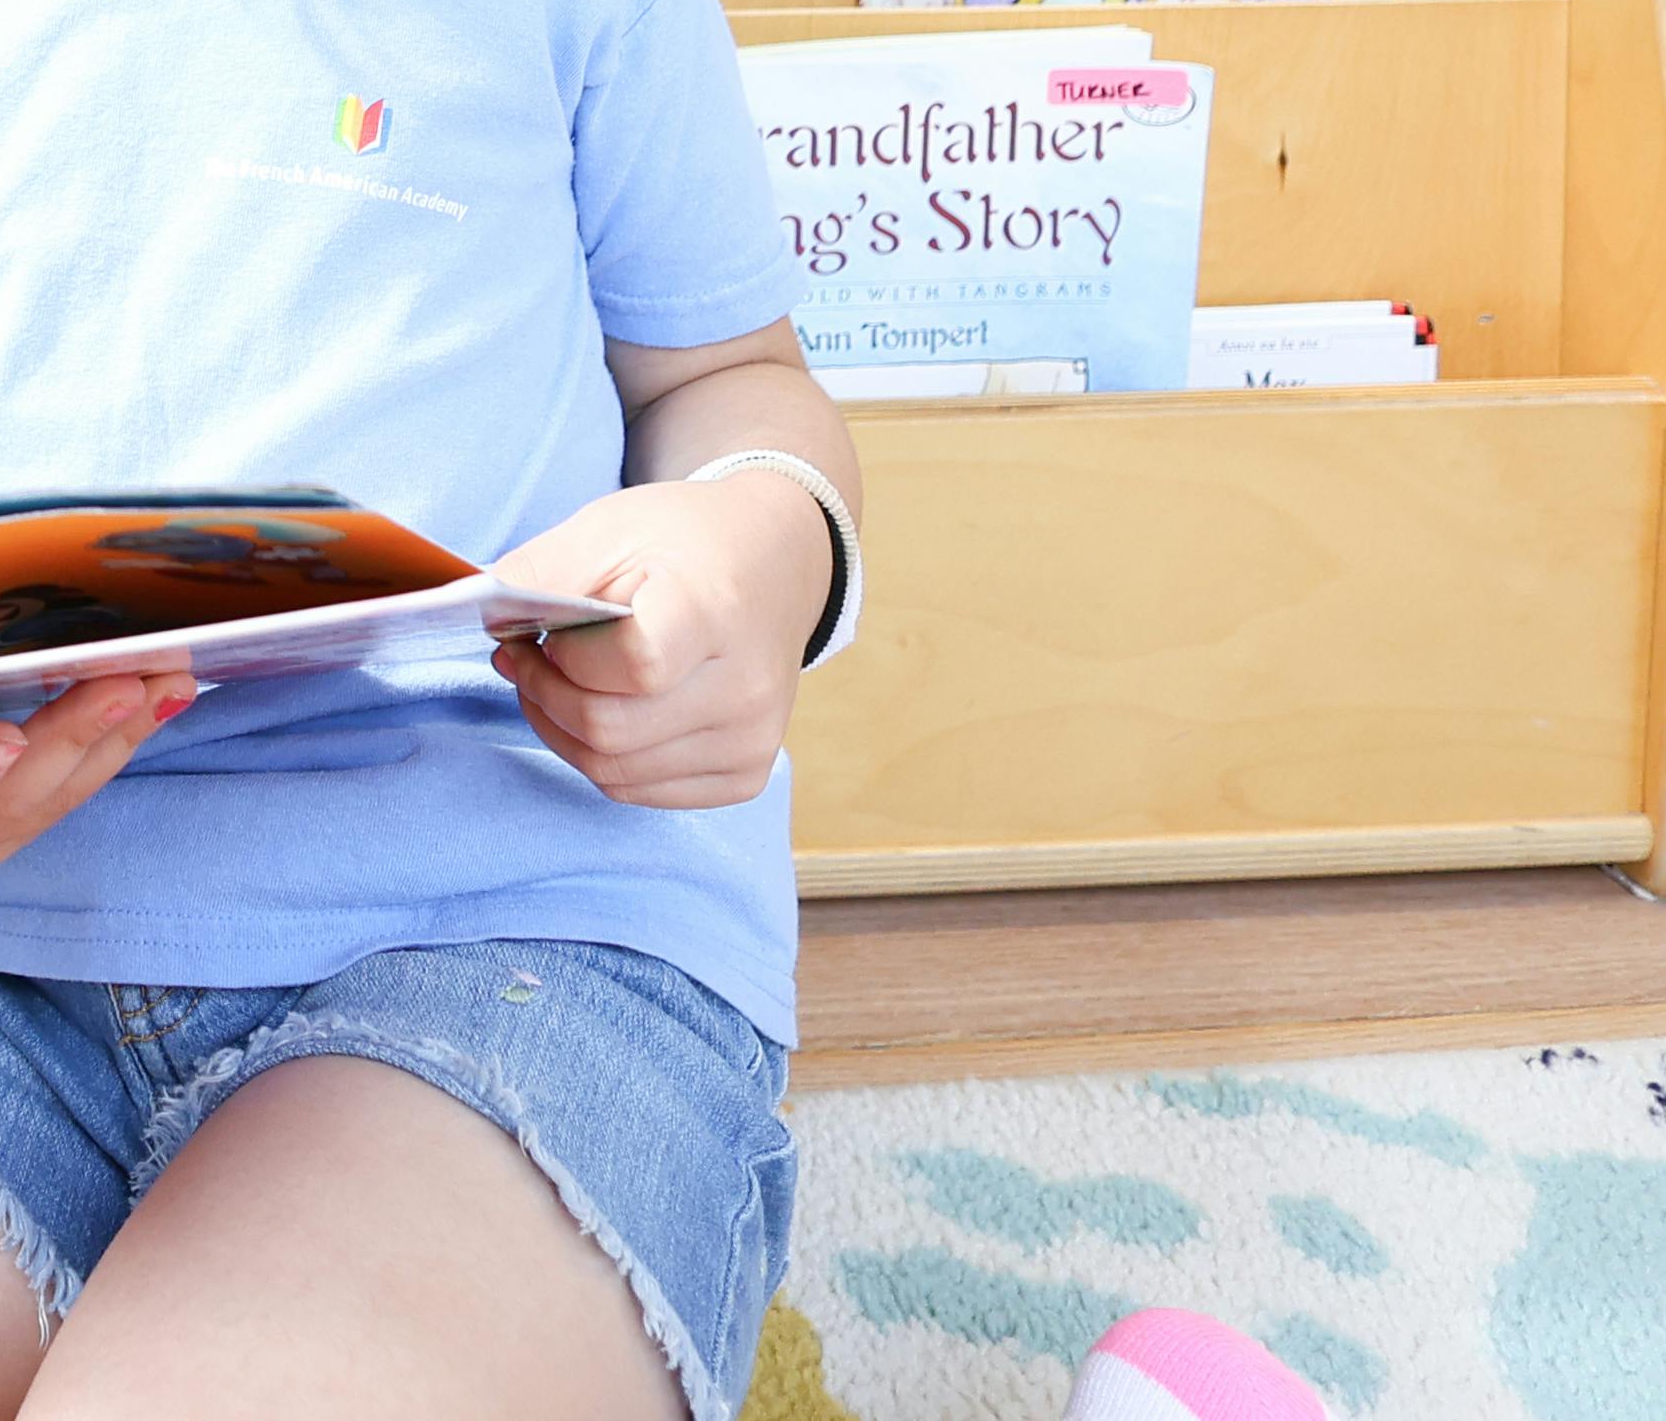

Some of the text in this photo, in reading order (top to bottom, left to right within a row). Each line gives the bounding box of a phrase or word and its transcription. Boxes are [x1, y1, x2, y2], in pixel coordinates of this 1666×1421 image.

[1056, 81, 1151, 102] TURNER
[307, 162, 400, 202] American
[401, 186, 470, 224] Academy
[926, 189, 1123, 267] Story
[867, 284, 940, 302] WITH
[958, 281, 1112, 301] TANGRAMS
[861, 320, 989, 355] Tompert
